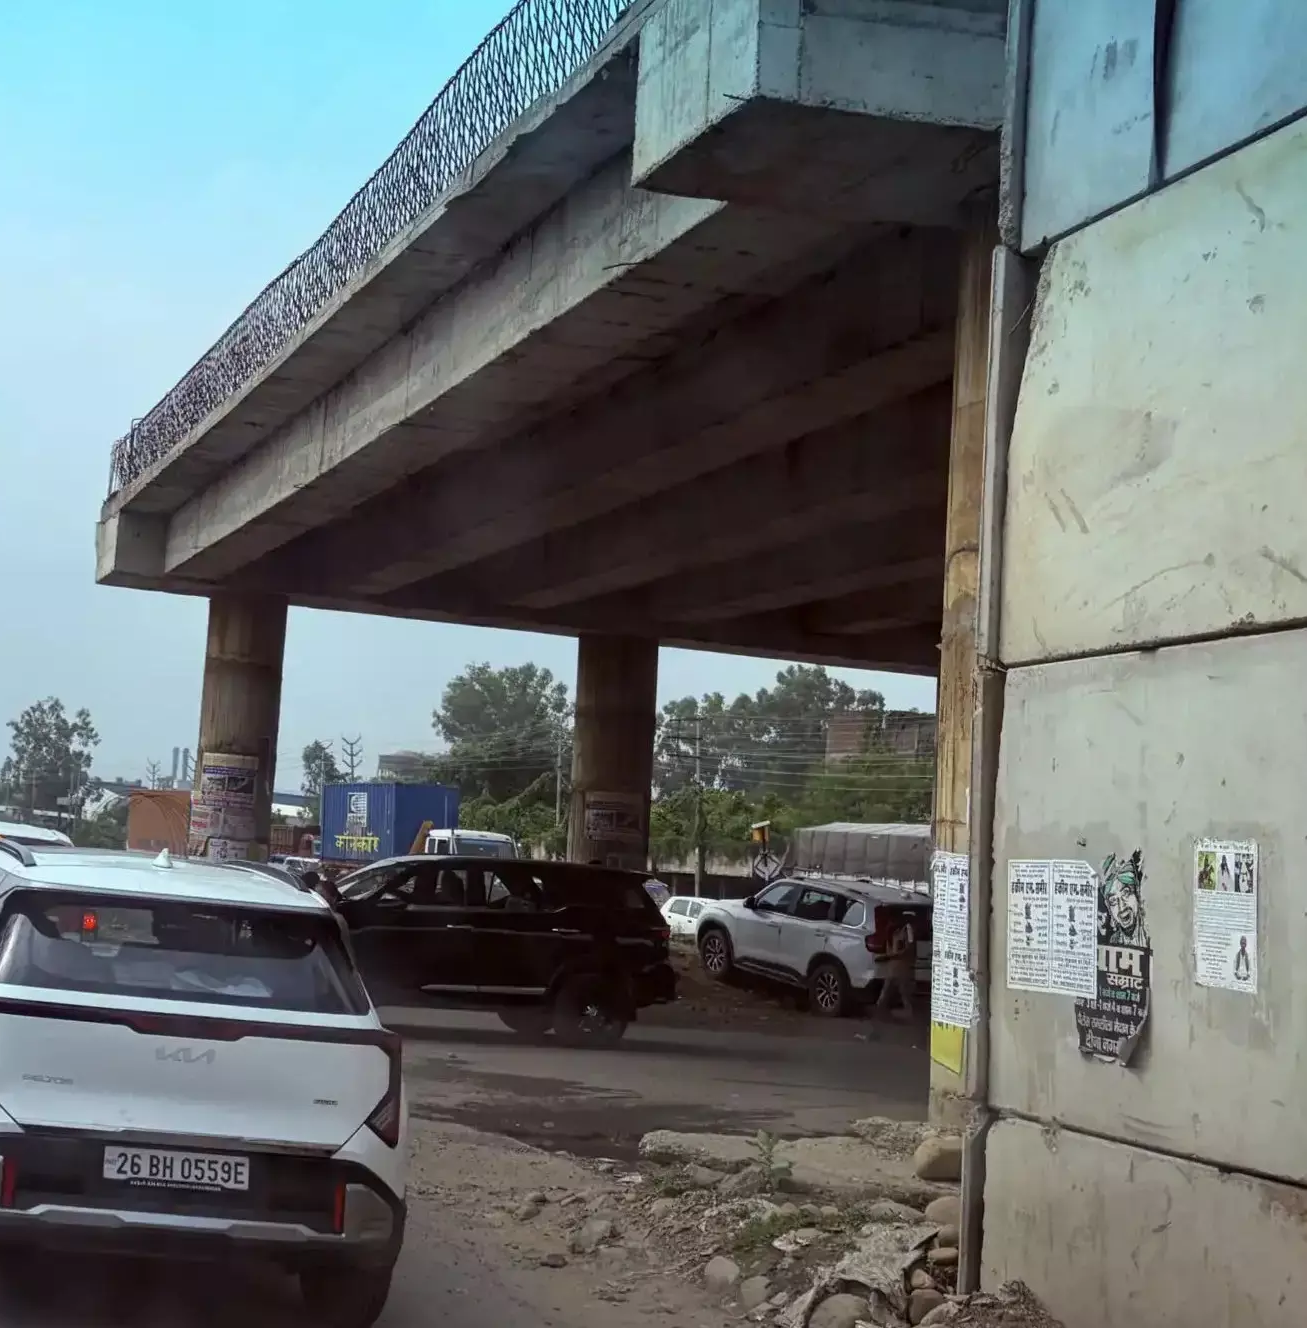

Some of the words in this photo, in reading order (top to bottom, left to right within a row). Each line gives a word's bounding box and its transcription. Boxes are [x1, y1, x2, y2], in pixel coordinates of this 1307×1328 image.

[116, 1152, 142, 1176] 26
[149, 1154, 174, 1179] BH
[180, 1156, 246, 1185] 0559E
